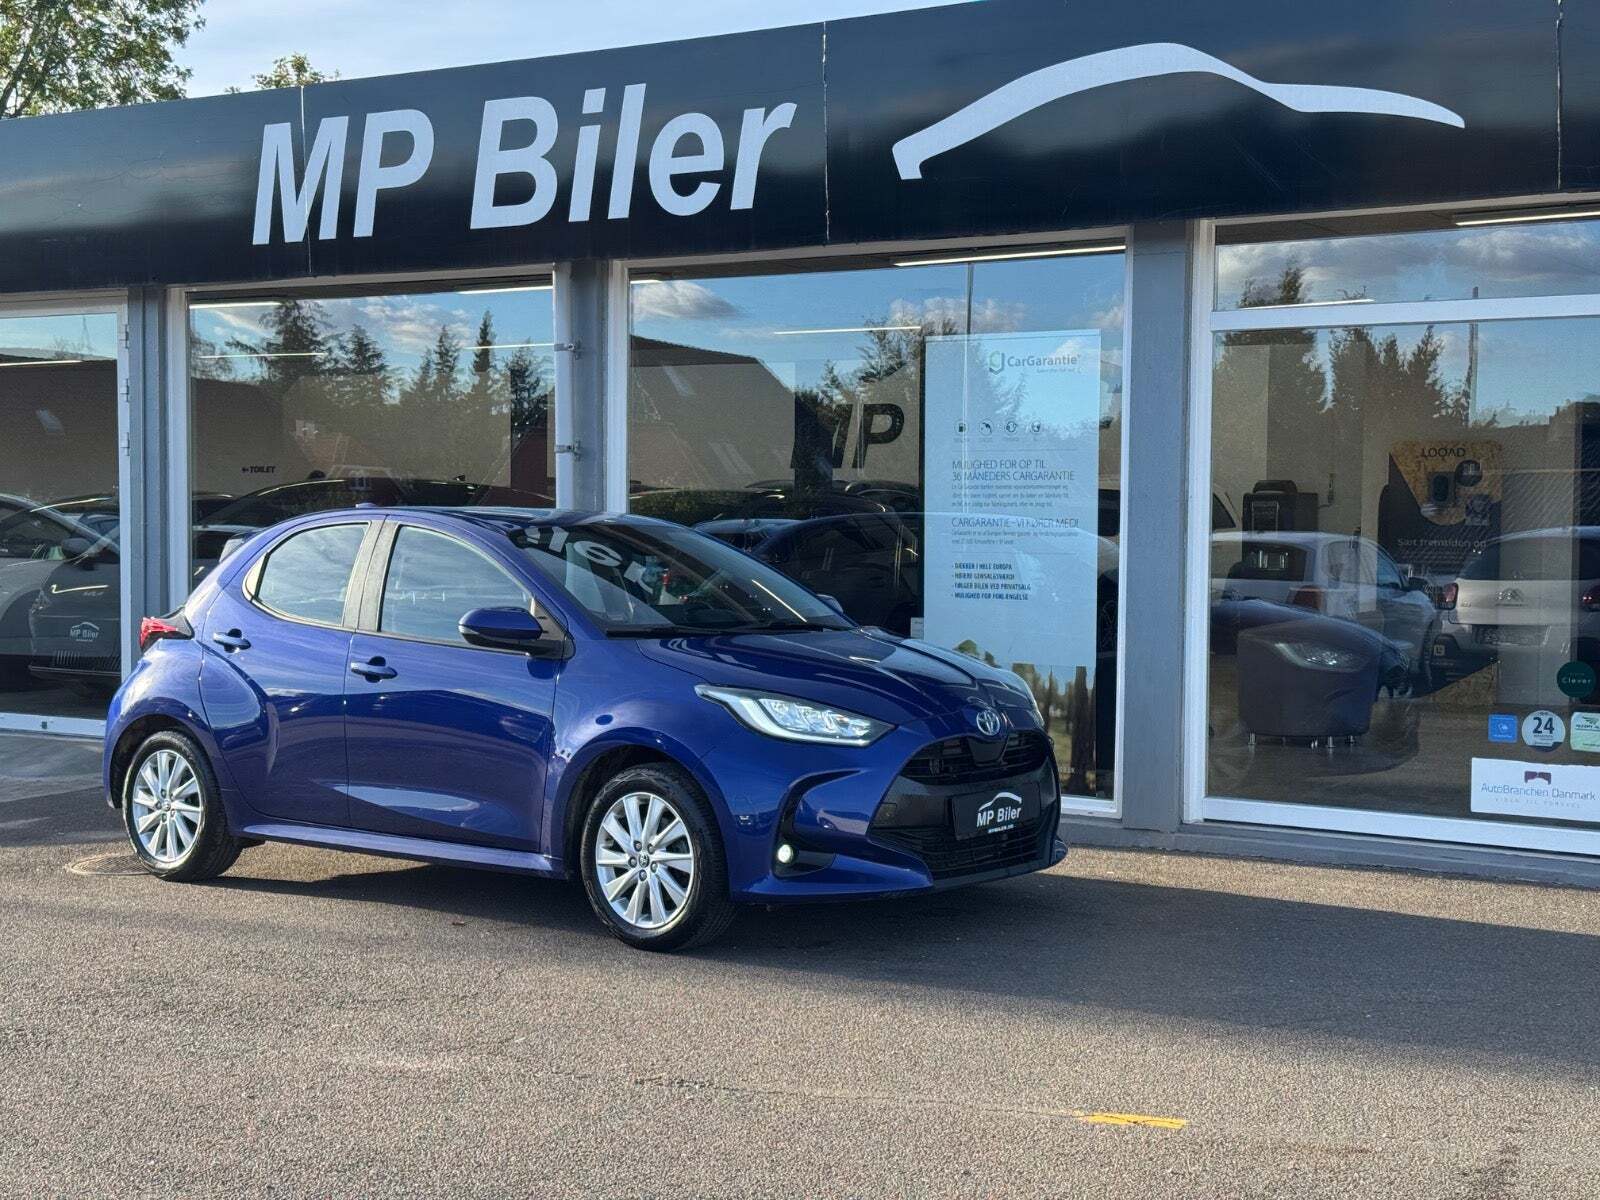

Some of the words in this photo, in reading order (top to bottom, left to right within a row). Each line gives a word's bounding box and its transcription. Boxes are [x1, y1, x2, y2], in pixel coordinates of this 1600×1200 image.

[252, 108, 435, 246] MP
[470, 83, 797, 229] Biler
[1007, 353, 1077, 367] CarGarantie
[250, 465, 276, 474] TOILET
[1000, 459, 1017, 470] FOR
[1019, 459, 1032, 470] OP
[1035, 459, 1047, 469] TIL
[1012, 470, 1075, 481] CARGARANTIE
[952, 518, 1010, 528] CARGARANTIE
[1532, 716, 1555, 735] 24
[1481, 782, 1549, 798] AutoBranchen
[1551, 788, 1596, 801] Danmark
[976, 811, 995, 828] MP
[997, 806, 1022, 823] Biler
